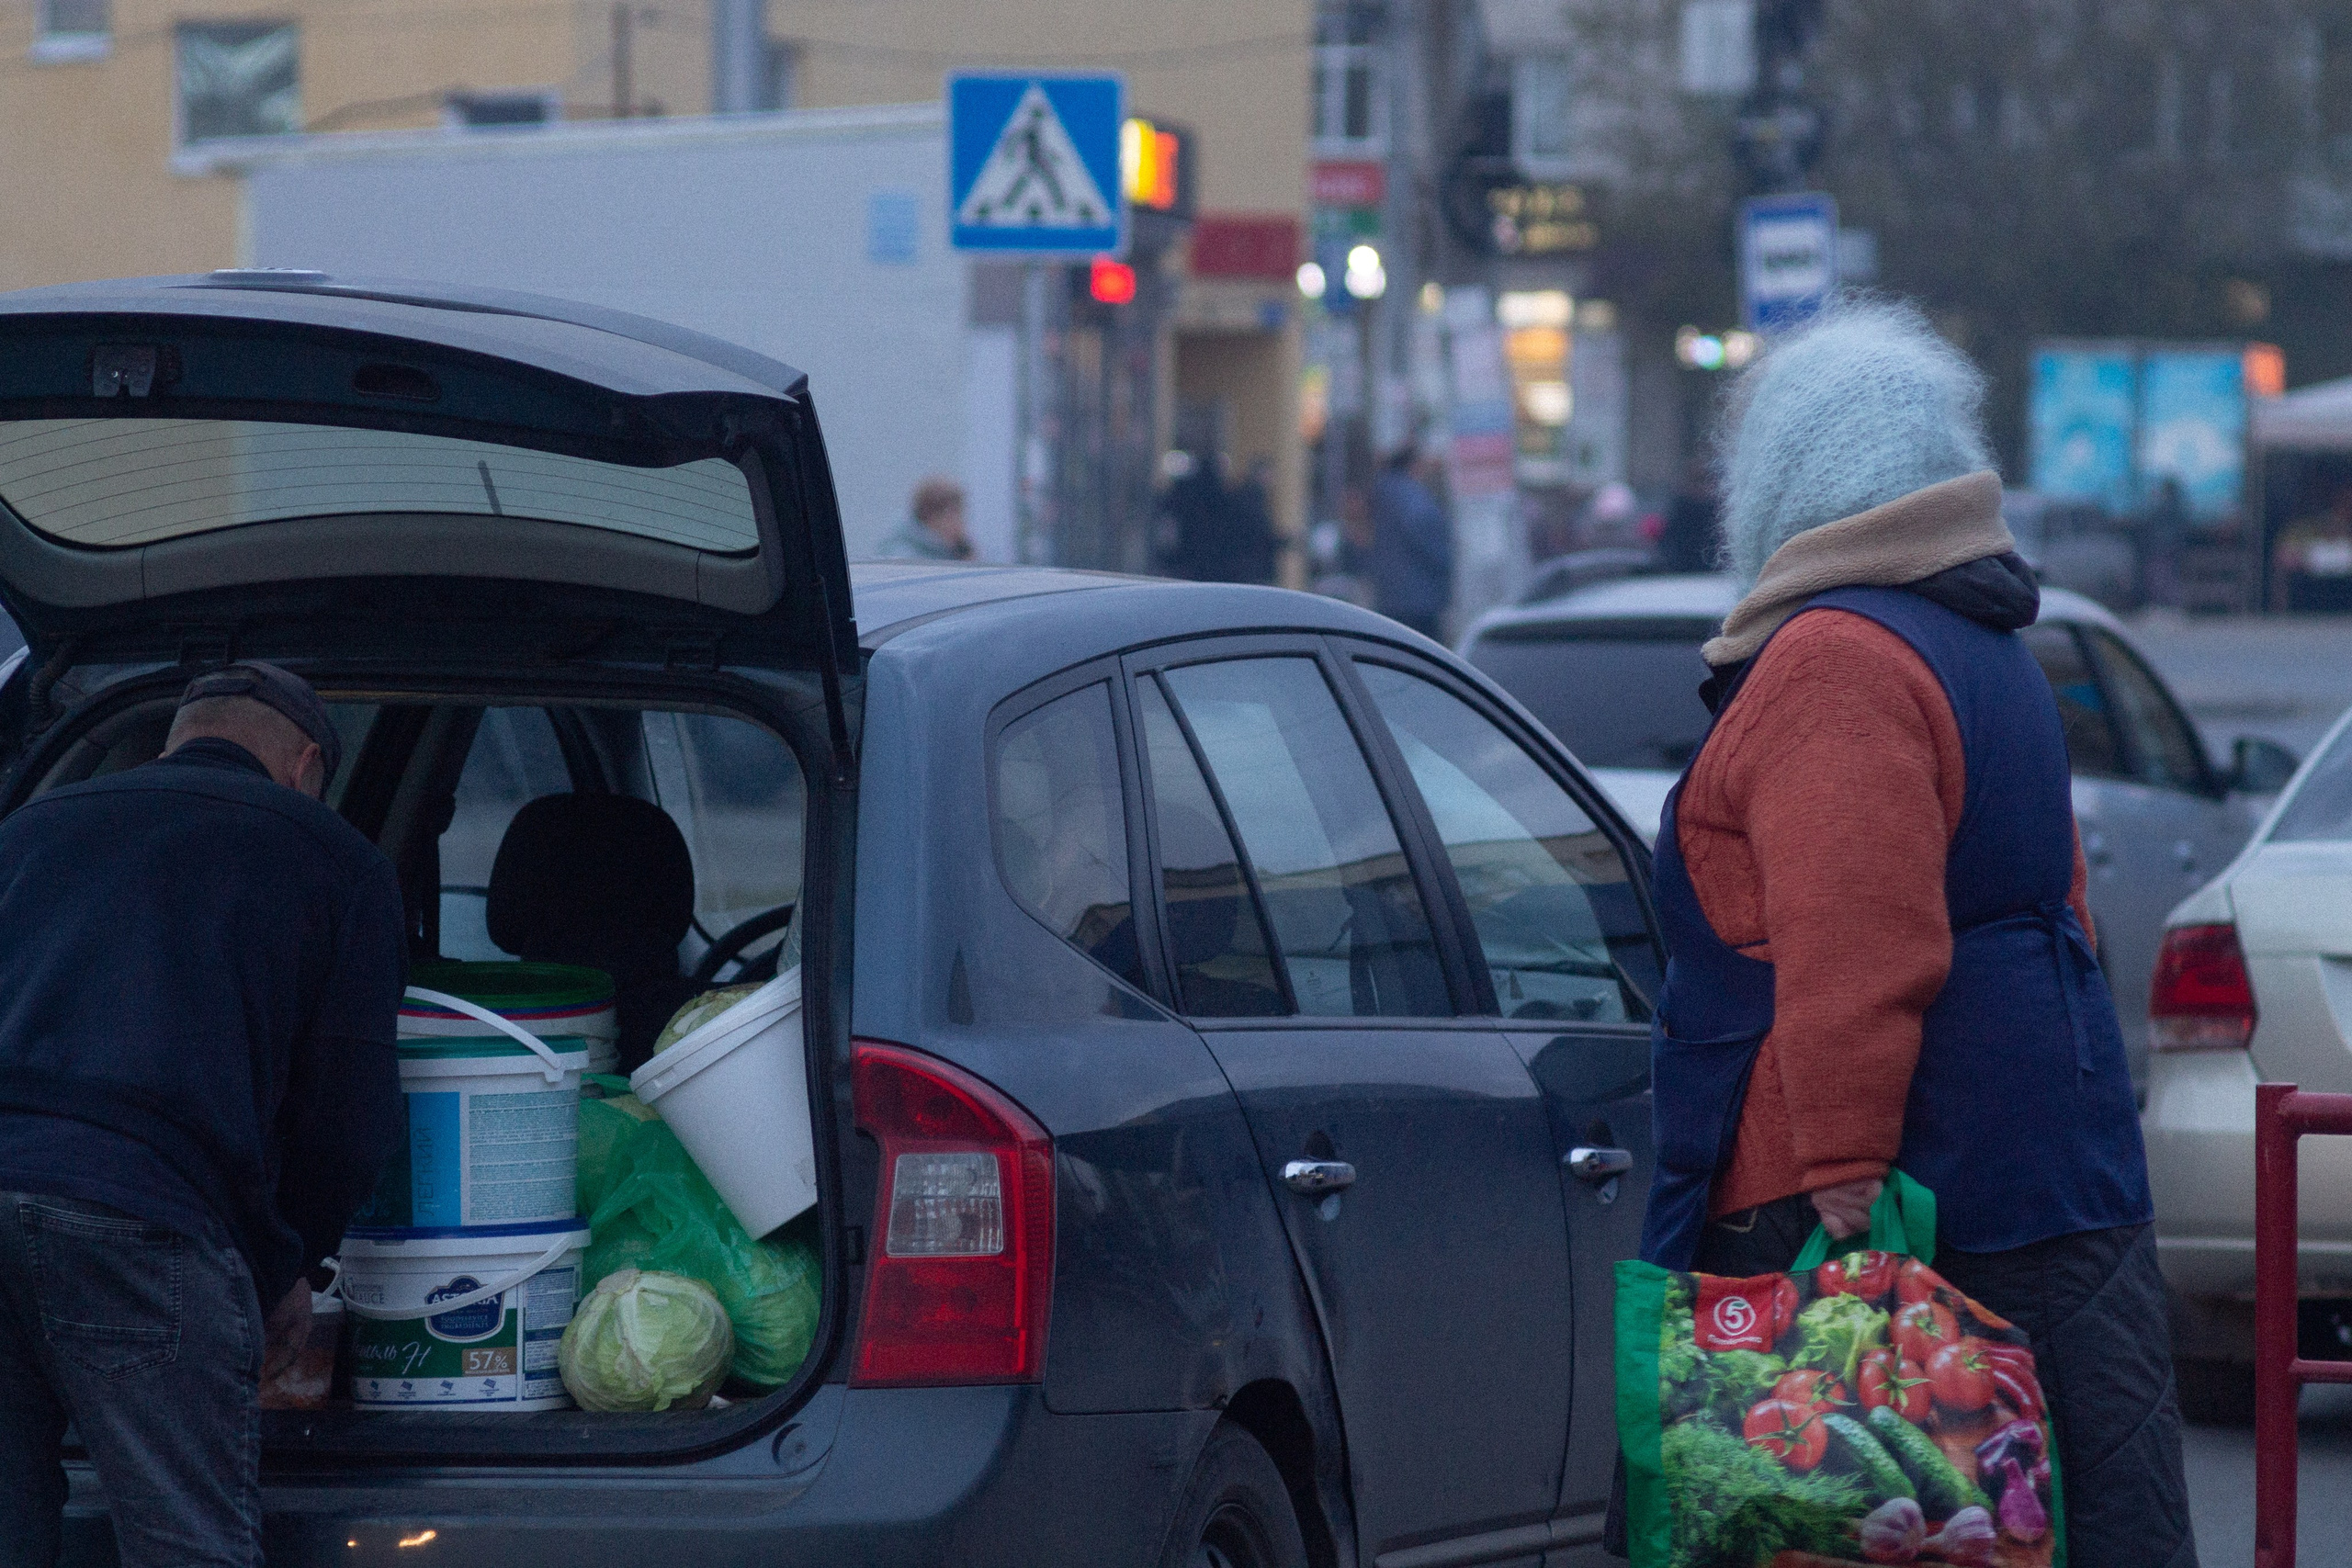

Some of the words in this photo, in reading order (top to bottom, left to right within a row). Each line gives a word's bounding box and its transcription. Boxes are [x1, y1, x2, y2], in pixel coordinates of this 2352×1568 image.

[413, 1126, 435, 1216] ЛЕГКИЙ
[432, 1291, 499, 1305] ASTIA
[1724, 1300, 1748, 1329] 5
[469, 1350, 508, 1371] 57%
